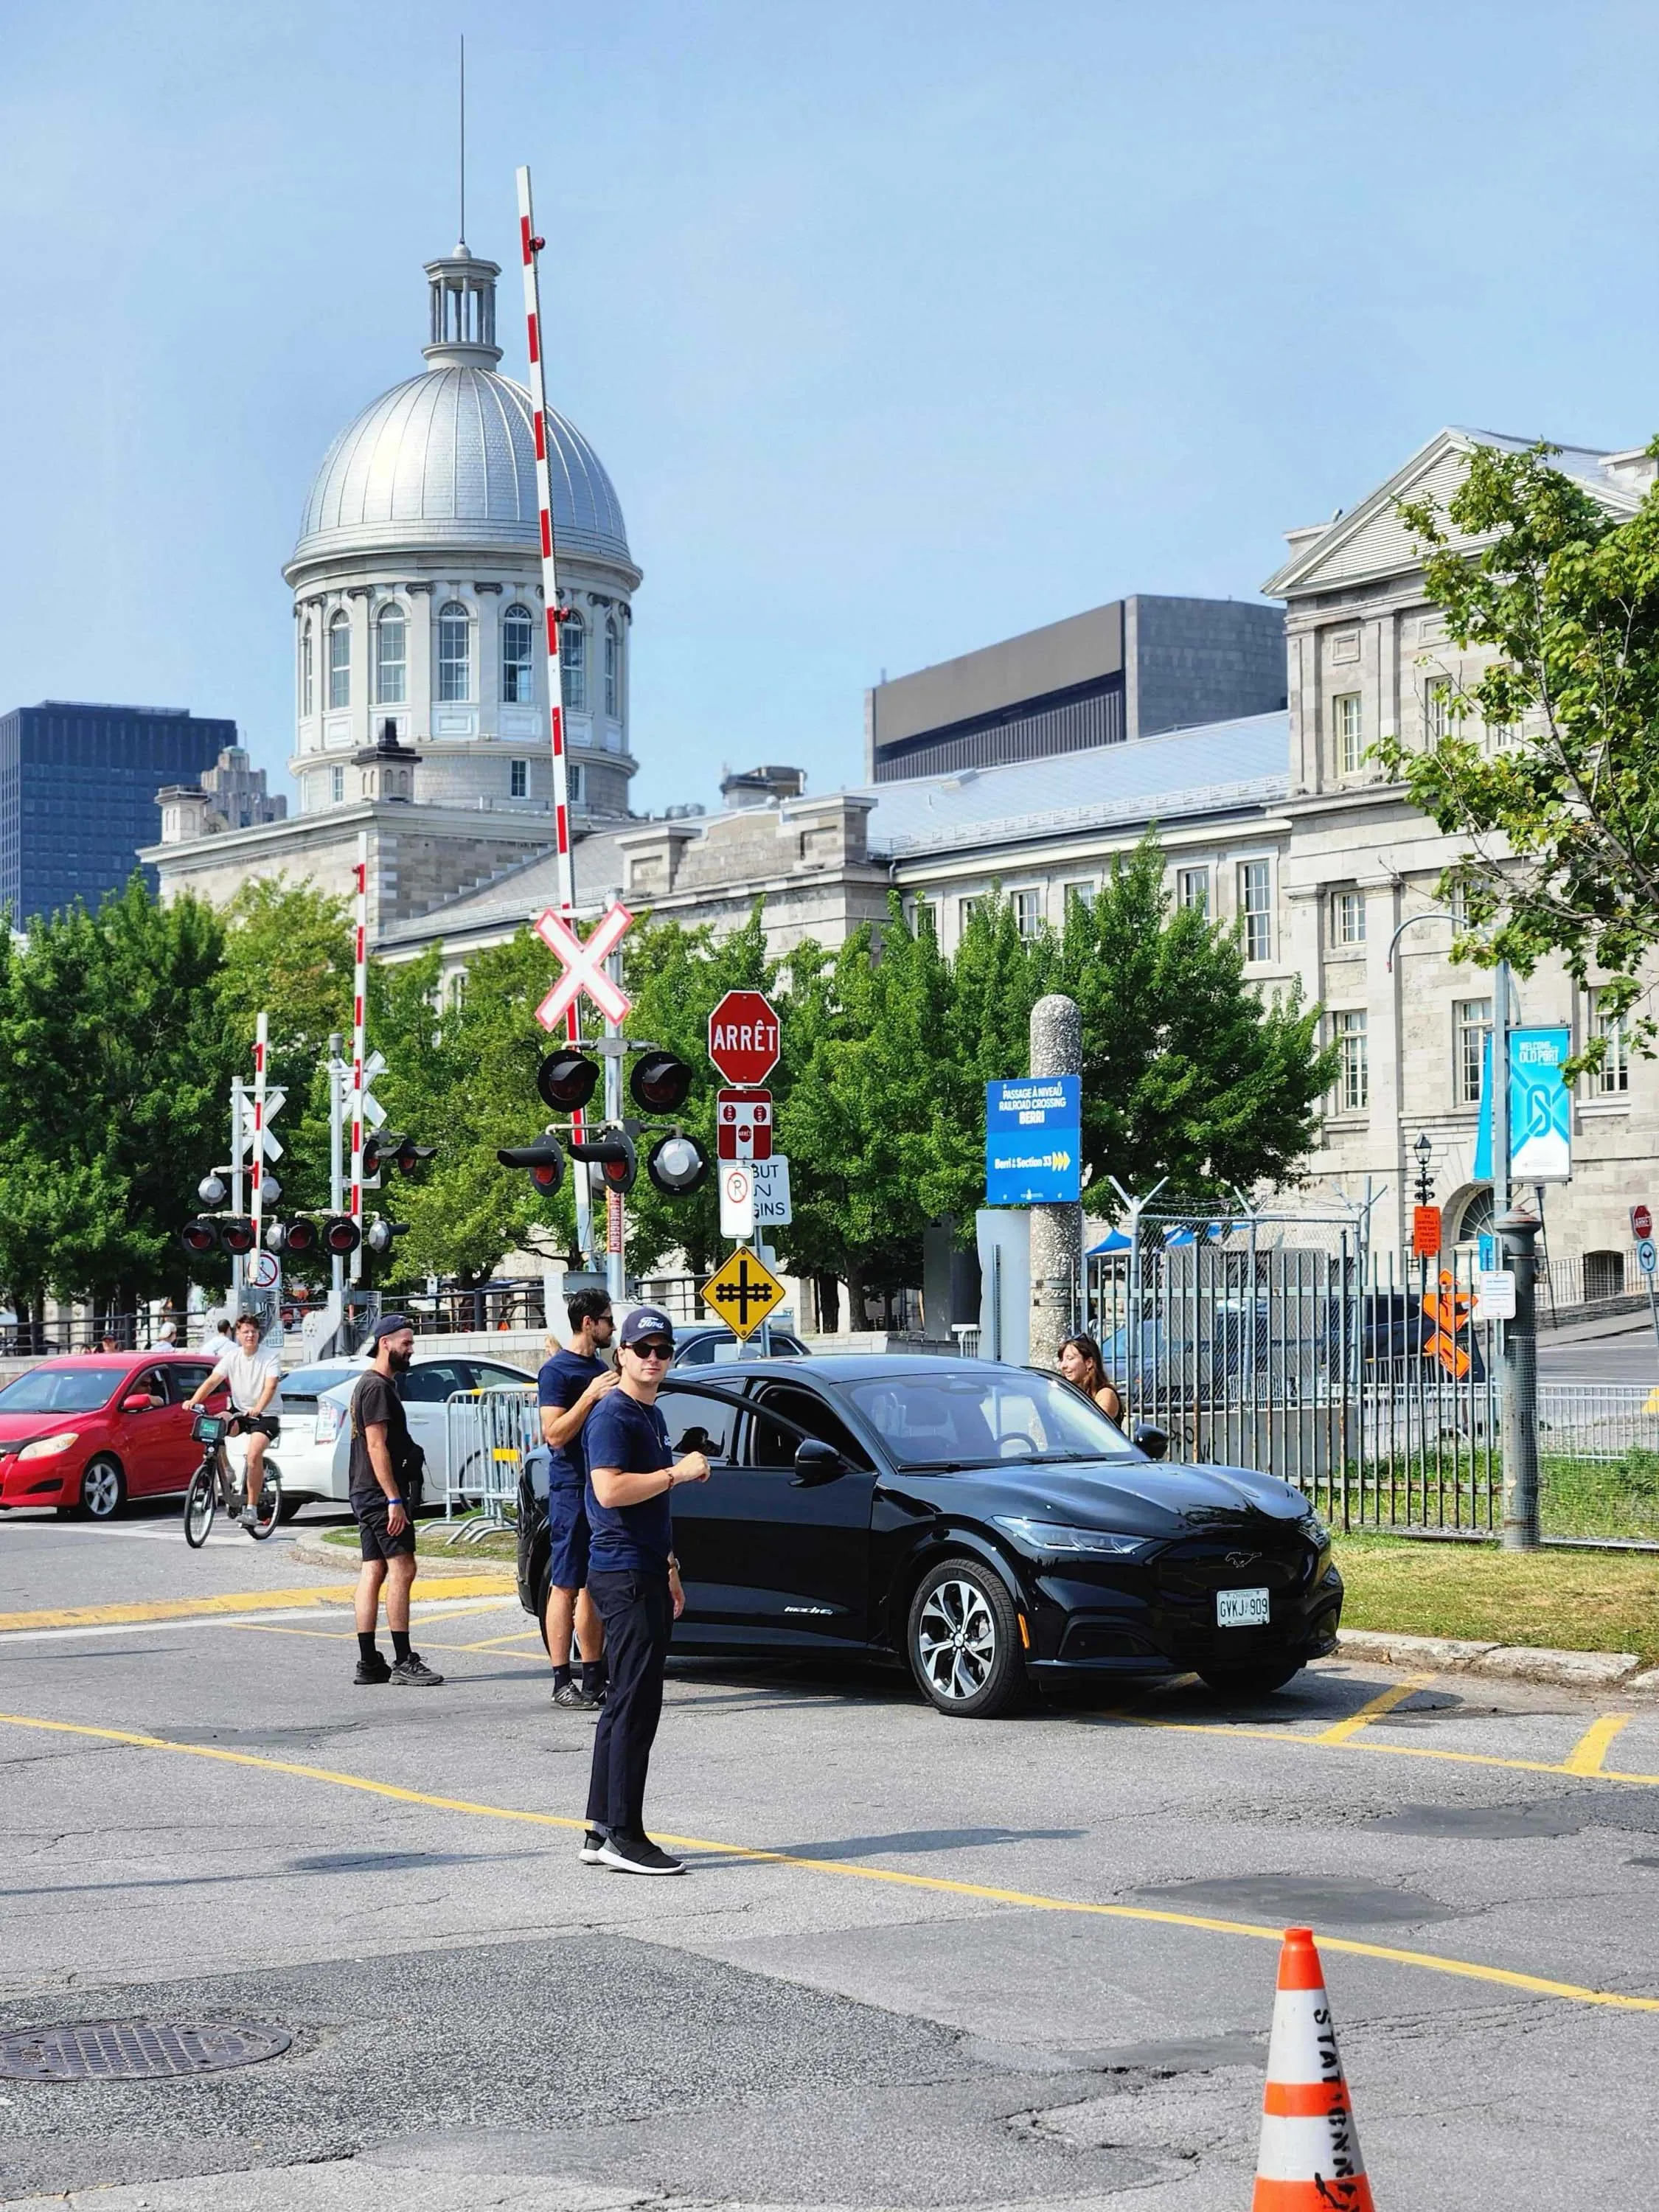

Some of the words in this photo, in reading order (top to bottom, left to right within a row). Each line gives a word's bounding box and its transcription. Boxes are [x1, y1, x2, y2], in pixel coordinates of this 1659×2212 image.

[713, 1019, 776, 1051] ARRÊT
[1520, 1049, 1536, 1063] OLD
[1003, 1088, 1032, 1100] PASSAGE
[1032, 1085, 1037, 1098] À
[1038, 1086, 1062, 1097] NIVEAU
[999, 1099, 1031, 1111] RAILROAD
[1032, 1096, 1066, 1109] CROSSING
[1019, 1110, 1045, 1124] BERRI
[1017, 1156, 1042, 1168] Section
[637, 1316, 664, 1329] Ford
[1220, 1599, 1244, 1617] GVKJ
[1250, 1598, 1267, 1615] 909
